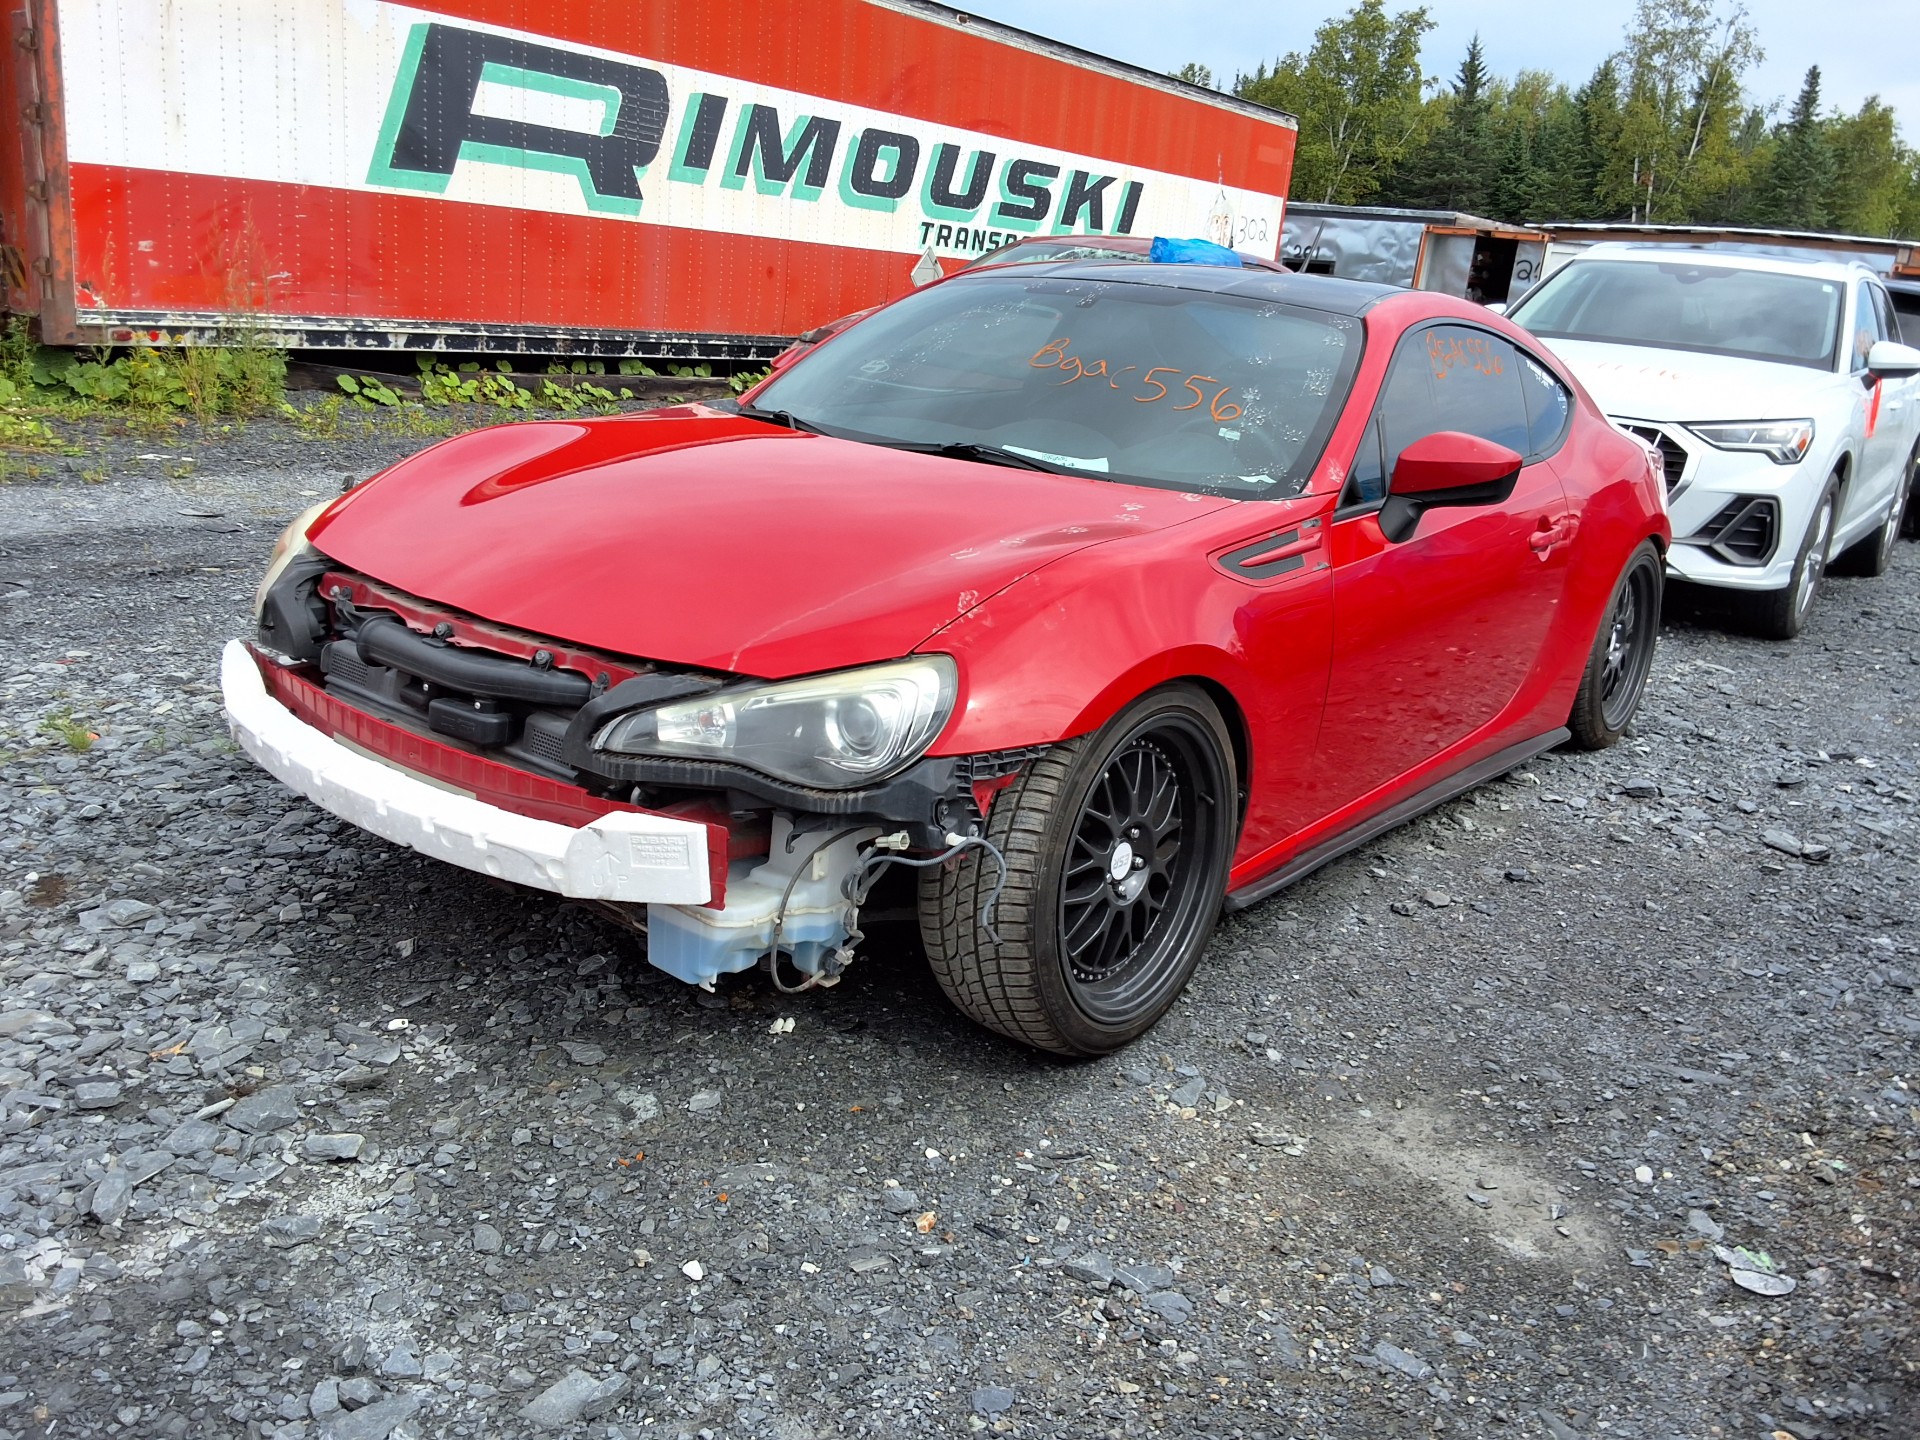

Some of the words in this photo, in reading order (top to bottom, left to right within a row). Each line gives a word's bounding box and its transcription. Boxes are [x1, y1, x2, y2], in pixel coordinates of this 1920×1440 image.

[366, 22, 1144, 235] RIMOUSKI
[920, 221, 1032, 253] TRANSP
[1237, 215, 1268, 244] 302
[631, 836, 687, 845] SUBARU
[591, 874, 629, 889] UP
